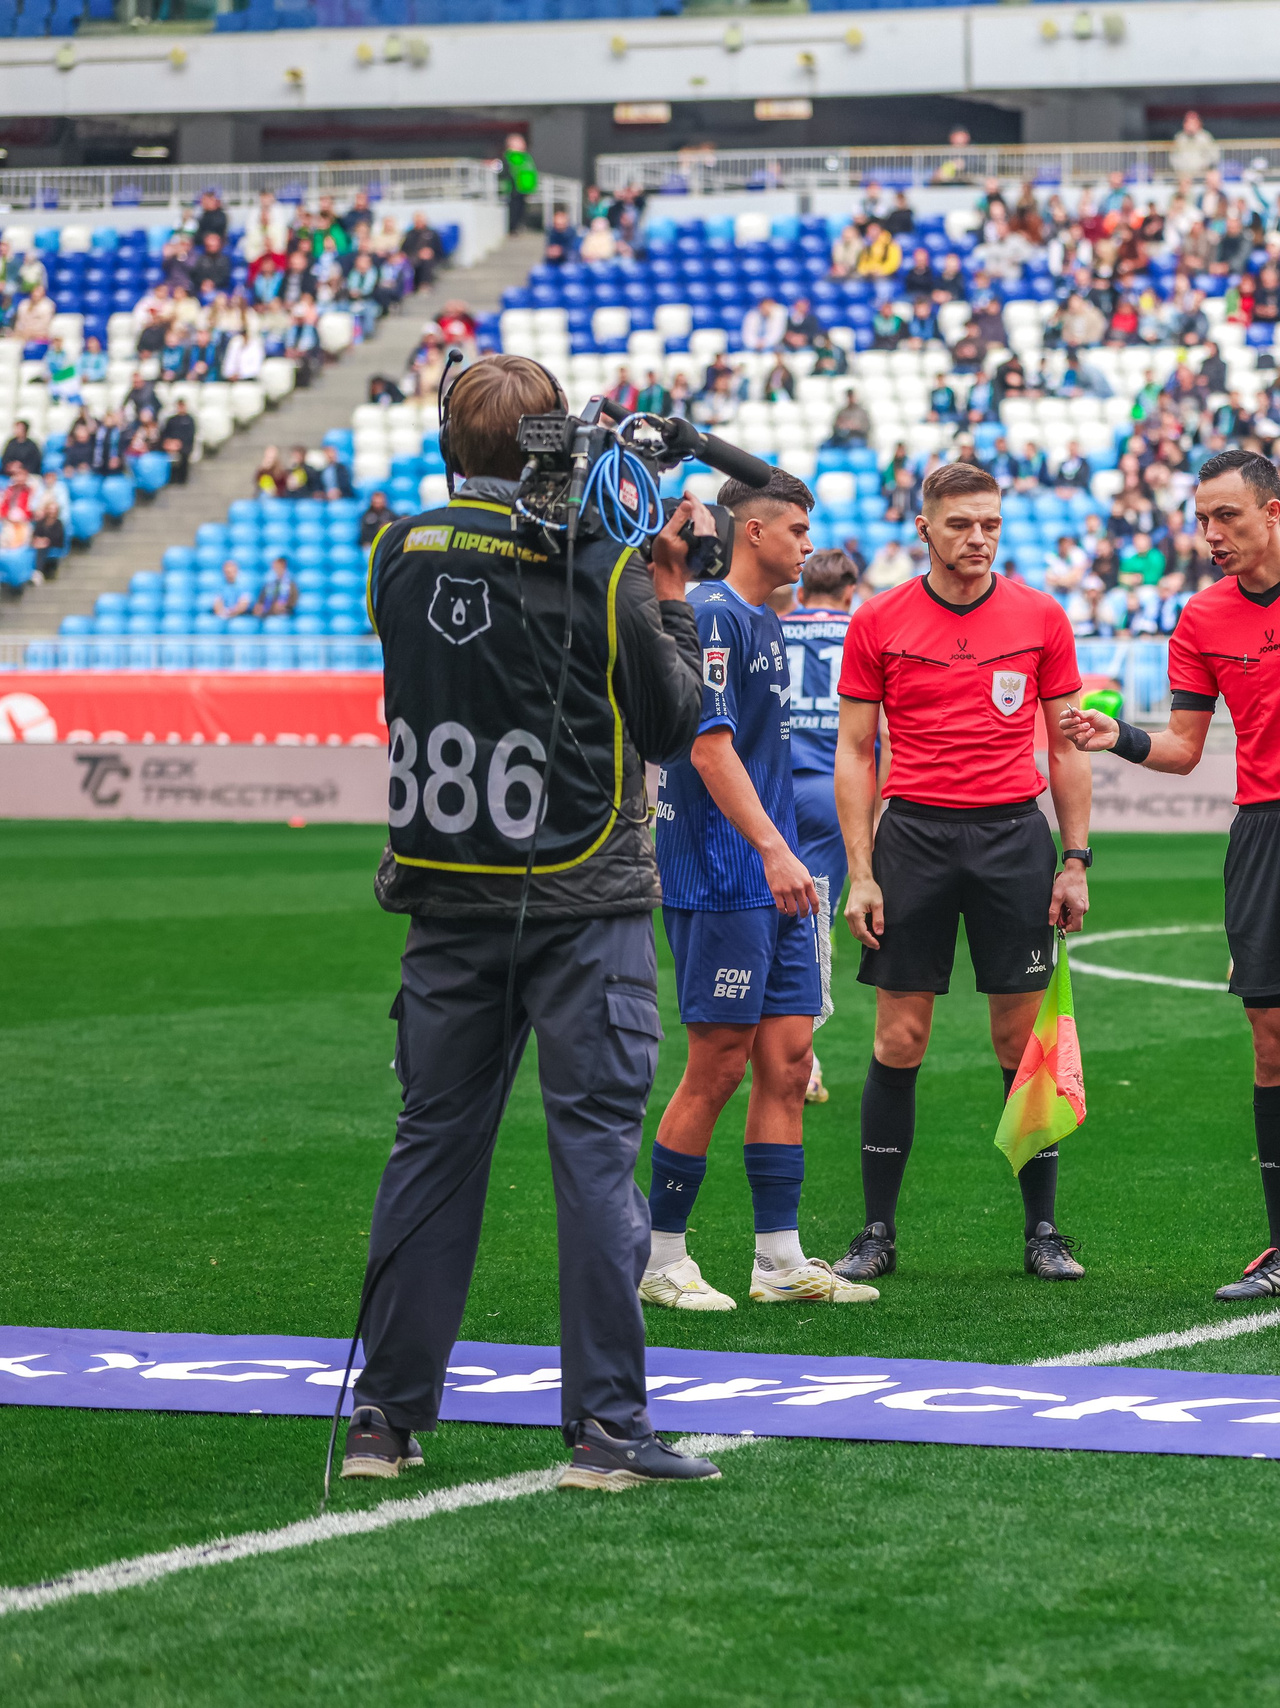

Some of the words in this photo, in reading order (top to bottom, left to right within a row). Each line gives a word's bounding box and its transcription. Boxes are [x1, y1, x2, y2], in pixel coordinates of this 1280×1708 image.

[388, 717, 549, 839] 886
[714, 968, 752, 984] FON
[713, 983, 751, 999] BET
